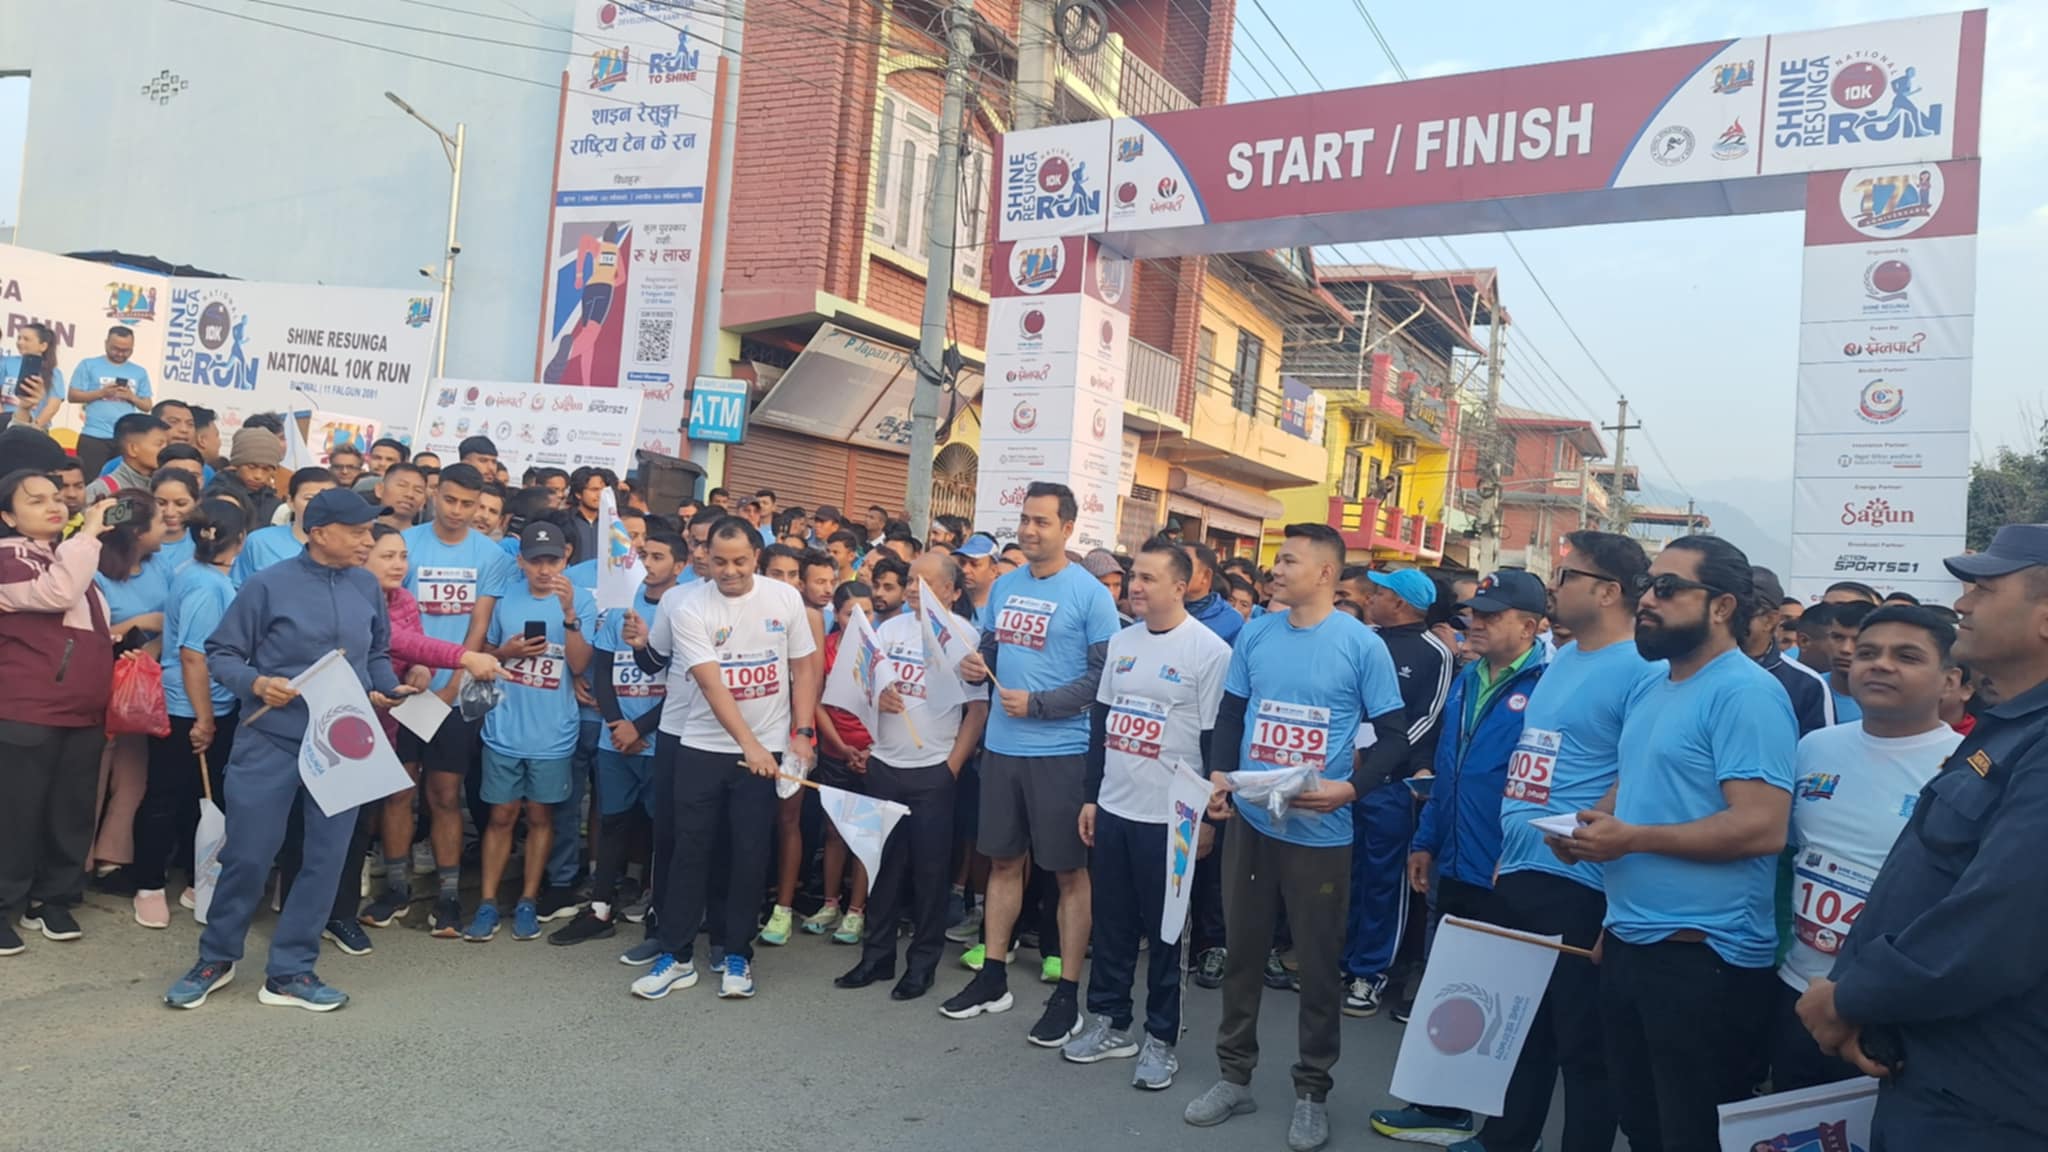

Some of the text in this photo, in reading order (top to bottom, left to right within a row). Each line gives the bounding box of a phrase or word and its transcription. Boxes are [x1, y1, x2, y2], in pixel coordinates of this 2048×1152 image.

[649, 72, 697, 84] TO SHINE
[1775, 58, 1808, 149] SHINE
[1803, 55, 1831, 147] RESUNGA
[1844, 84, 1873, 101] 10K
[1828, 103, 1943, 146] RUN
[622, 132, 645, 151] टेन
[650, 130, 667, 150] के
[672, 133, 696, 149] रन
[1226, 128, 1375, 191] START
[1385, 123, 1402, 175] /
[1415, 102, 1594, 171] FINISH
[1007, 153, 1025, 222] SHINE
[1023, 151, 1038, 221] RESUNGA
[1036, 190, 1101, 220] RUN
[663, 248, 692, 262] लाख
[164, 288, 187, 380] SHINE
[179, 289, 200, 382] RESUNGA
[287, 327, 387, 352] SHINE RESUNGA
[855, 341, 889, 360] Japan
[192, 352, 259, 390] RUN
[267, 351, 411, 384] NATIONAL 10K RUN
[331, 386, 361, 397] FALGUN
[690, 394, 742, 428] ATM
[1841, 500, 1915, 527] Sagun
[1833, 561, 1897, 572] SPORTS
[429, 583, 468, 600] 196
[1002, 610, 1046, 634] 1055
[513, 657, 554, 675] 218
[724, 664, 777, 686] 1008
[1111, 713, 1161, 740] 1099
[1260, 721, 1324, 751] 1039
